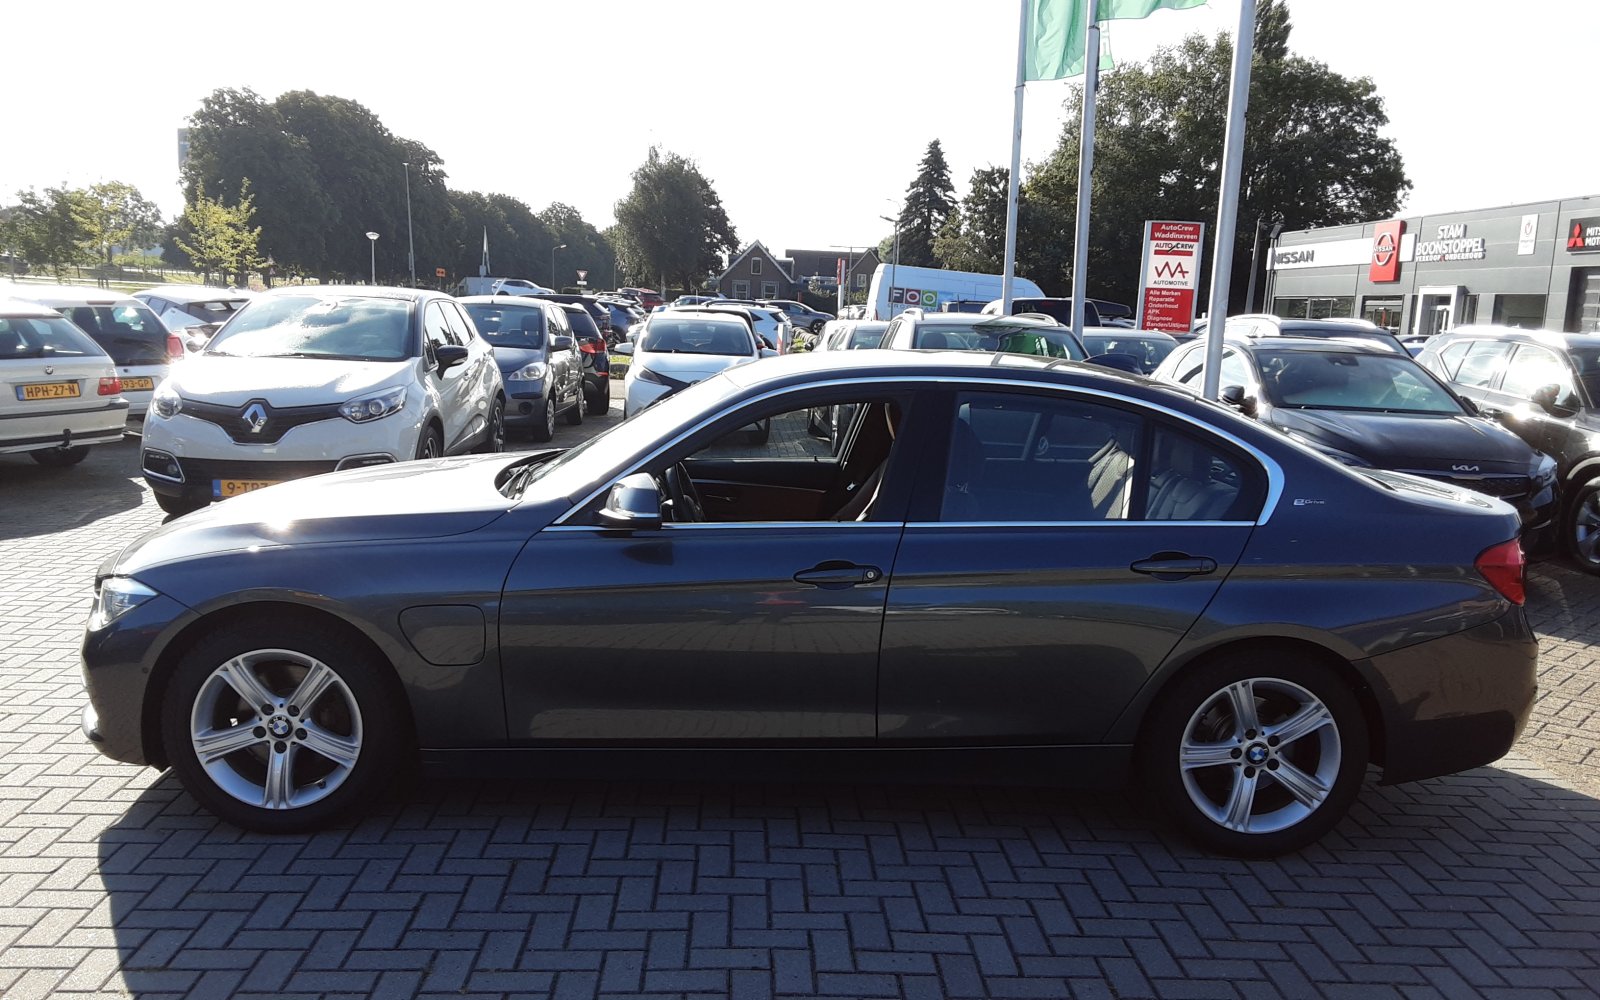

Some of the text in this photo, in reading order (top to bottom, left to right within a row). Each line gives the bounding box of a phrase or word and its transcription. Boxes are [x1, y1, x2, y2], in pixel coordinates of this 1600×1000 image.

[1154, 232, 1198, 240] Waddinxveen
[1437, 224, 1465, 240] STAM
[1416, 238, 1484, 256] BOONSTOPPEL
[1584, 236, 1600, 247] MOT
[1274, 250, 1315, 265] NISSAN
[26, 386, 76, 398] HPH-27-N
